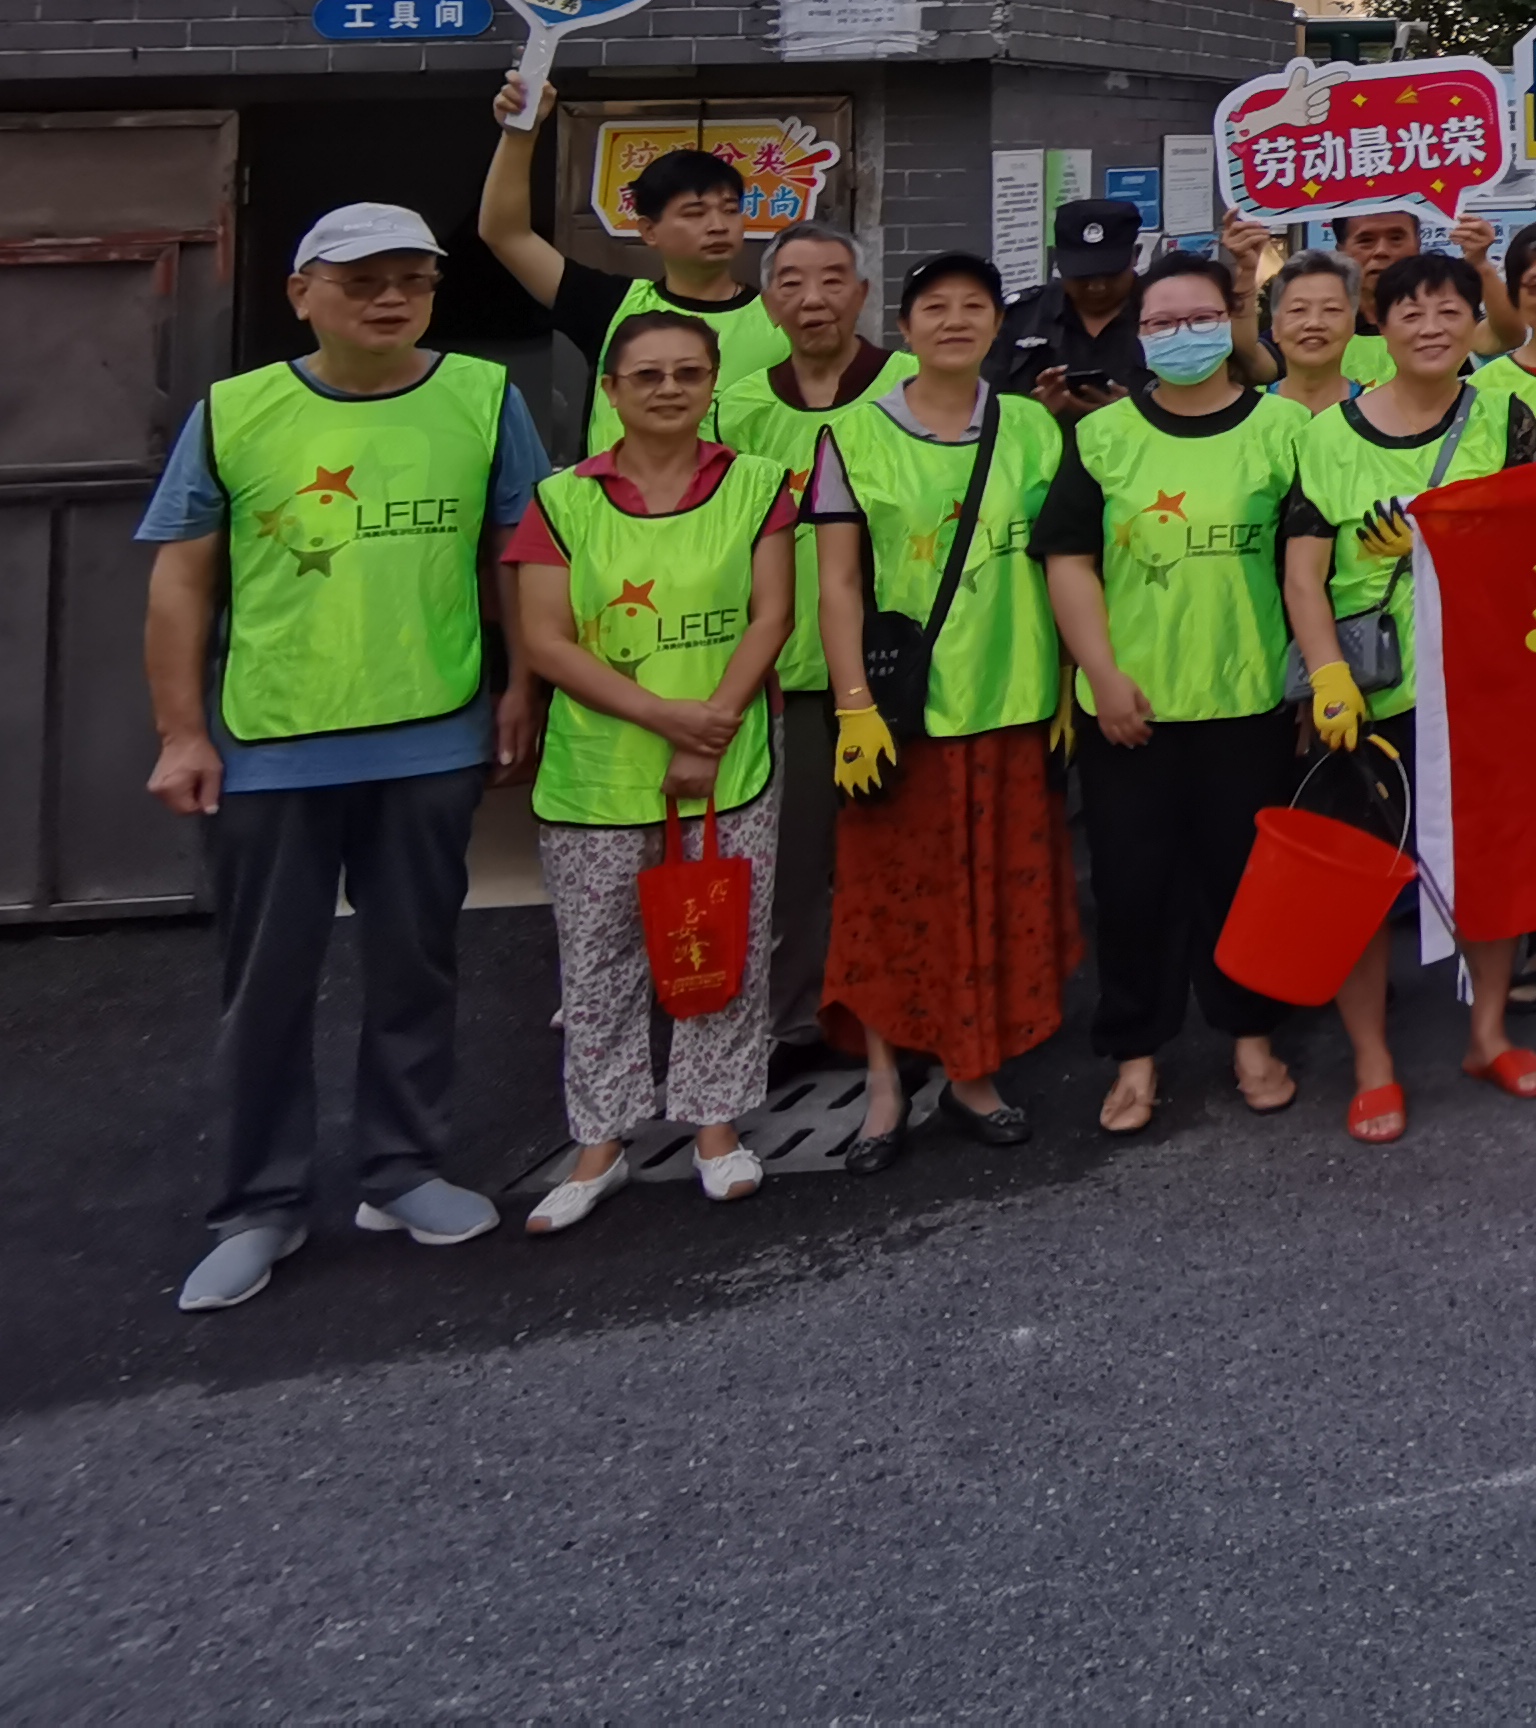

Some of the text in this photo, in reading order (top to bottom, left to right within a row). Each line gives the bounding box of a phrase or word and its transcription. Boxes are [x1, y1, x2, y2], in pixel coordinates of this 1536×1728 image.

[343, 0, 464, 29] 工具间
[1252, 114, 1488, 190] 劳动最光荣
[356, 498, 460, 531] LFCF
[986, 521, 1028, 551] LF
[1186, 523, 1263, 550] LFCF
[657, 608, 739, 643] LFCF
